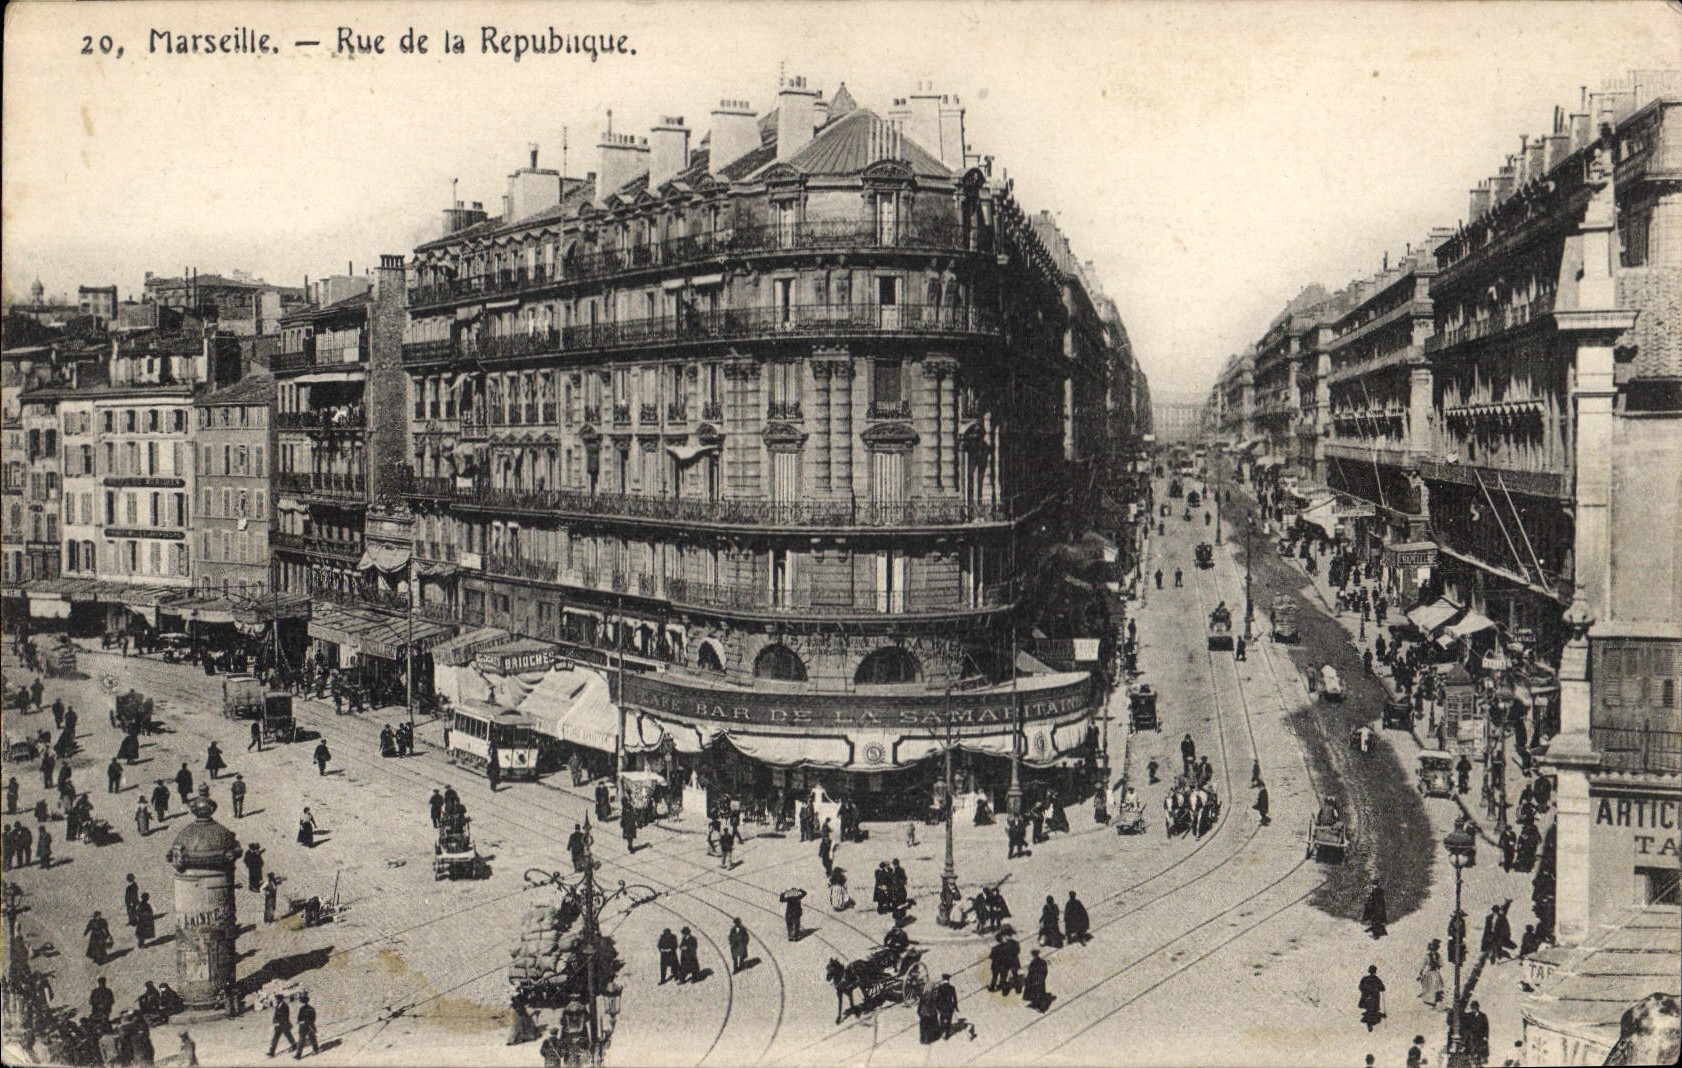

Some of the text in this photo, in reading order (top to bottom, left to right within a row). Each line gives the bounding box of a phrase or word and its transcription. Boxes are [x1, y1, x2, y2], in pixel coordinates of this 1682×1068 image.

[695, 702, 751, 720] BAR
[769, 708, 813, 723] DE
[833, 709, 879, 724] LA
